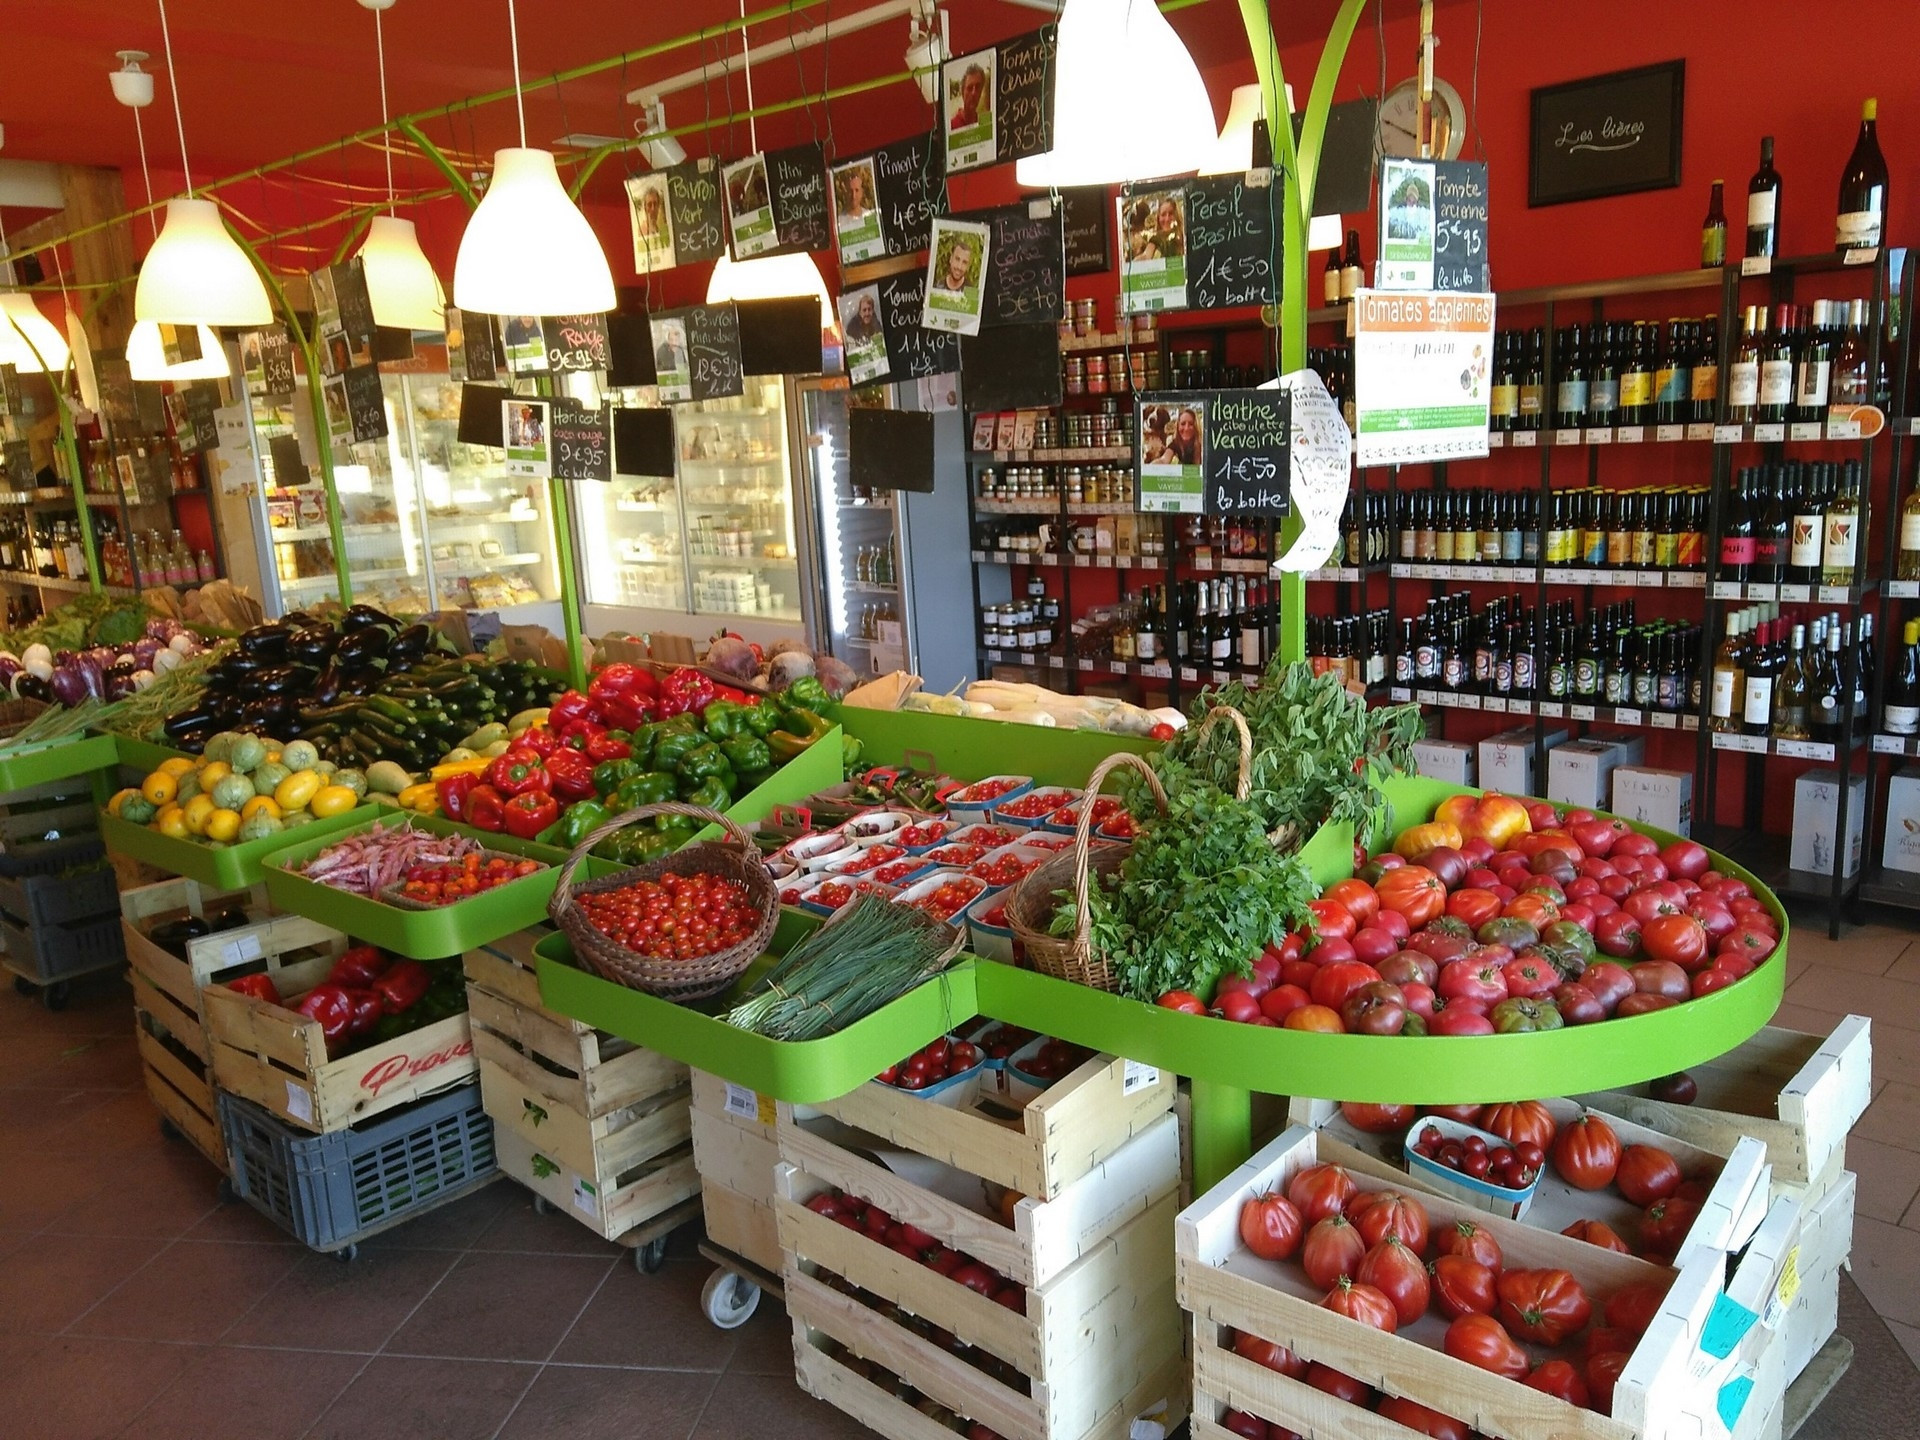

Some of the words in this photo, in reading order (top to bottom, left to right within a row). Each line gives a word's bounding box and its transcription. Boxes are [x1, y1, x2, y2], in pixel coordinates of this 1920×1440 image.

[1555, 122, 1593, 147] Les
[1601, 116, 1645, 139] bières
[877, 147, 920, 179] Piment
[667, 175, 716, 201] Poivron
[673, 203, 703, 225] Vert
[1189, 183, 1243, 222] Persil
[1191, 219, 1262, 250] Basilic
[883, 278, 925, 306] Tomat
[1361, 295, 1423, 323] Tomates
[559, 328, 605, 360] Rouge
[553, 407, 602, 426] Haricot
[1211, 393, 1277, 421] Menthe
[1211, 427, 1286, 450] Verveine
[1222, 420, 1286, 433] ciboulette
[1215, 455, 1277, 482] 1€50
[1623, 781, 1671, 793] VENUS
